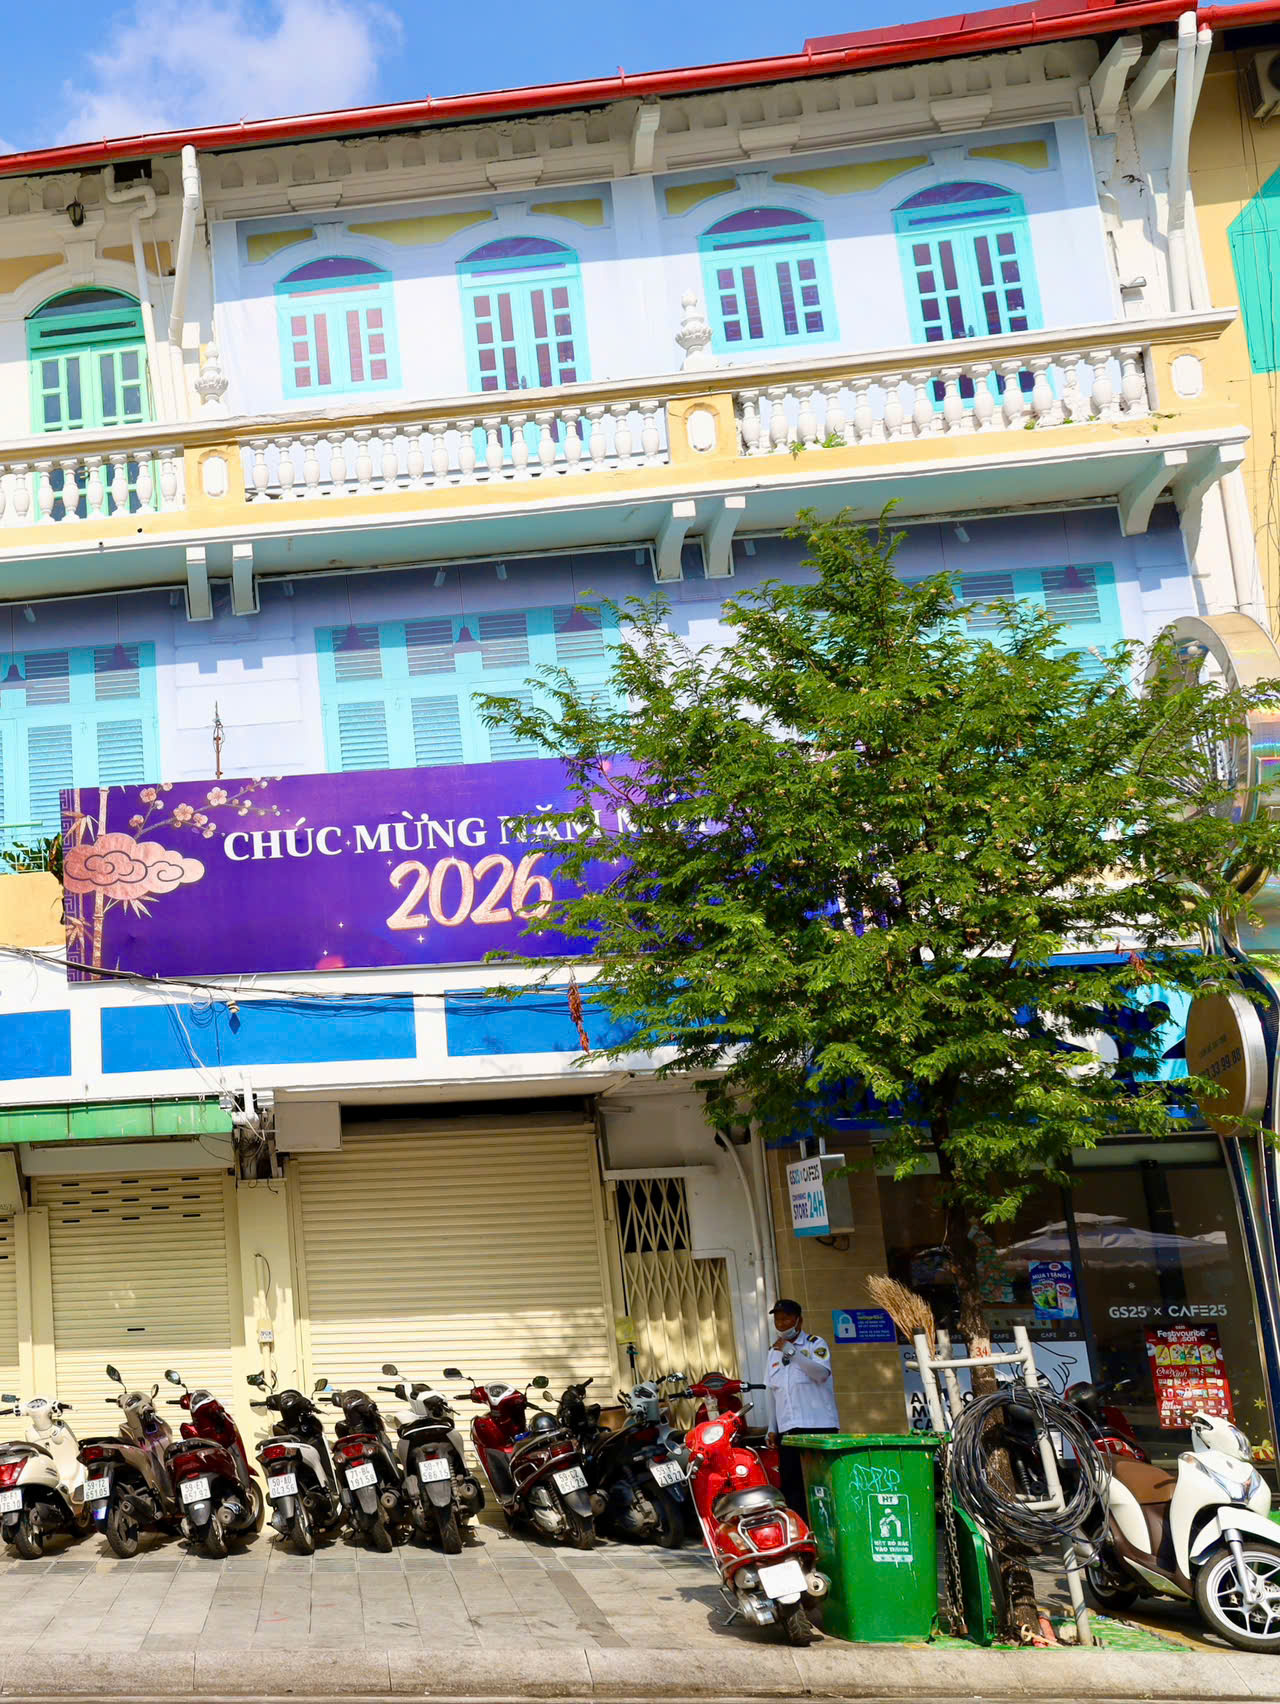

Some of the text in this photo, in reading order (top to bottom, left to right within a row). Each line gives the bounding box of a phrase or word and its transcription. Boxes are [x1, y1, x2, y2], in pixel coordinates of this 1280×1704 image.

[223, 816, 342, 861] CHÚC
[354, 812, 487, 855] MỪNG
[385, 852, 554, 931] 2026
[807, 1190, 825, 1218] 24H
[1108, 1306, 1148, 1319] GS25
[1168, 1304, 1228, 1317] CAFE25
